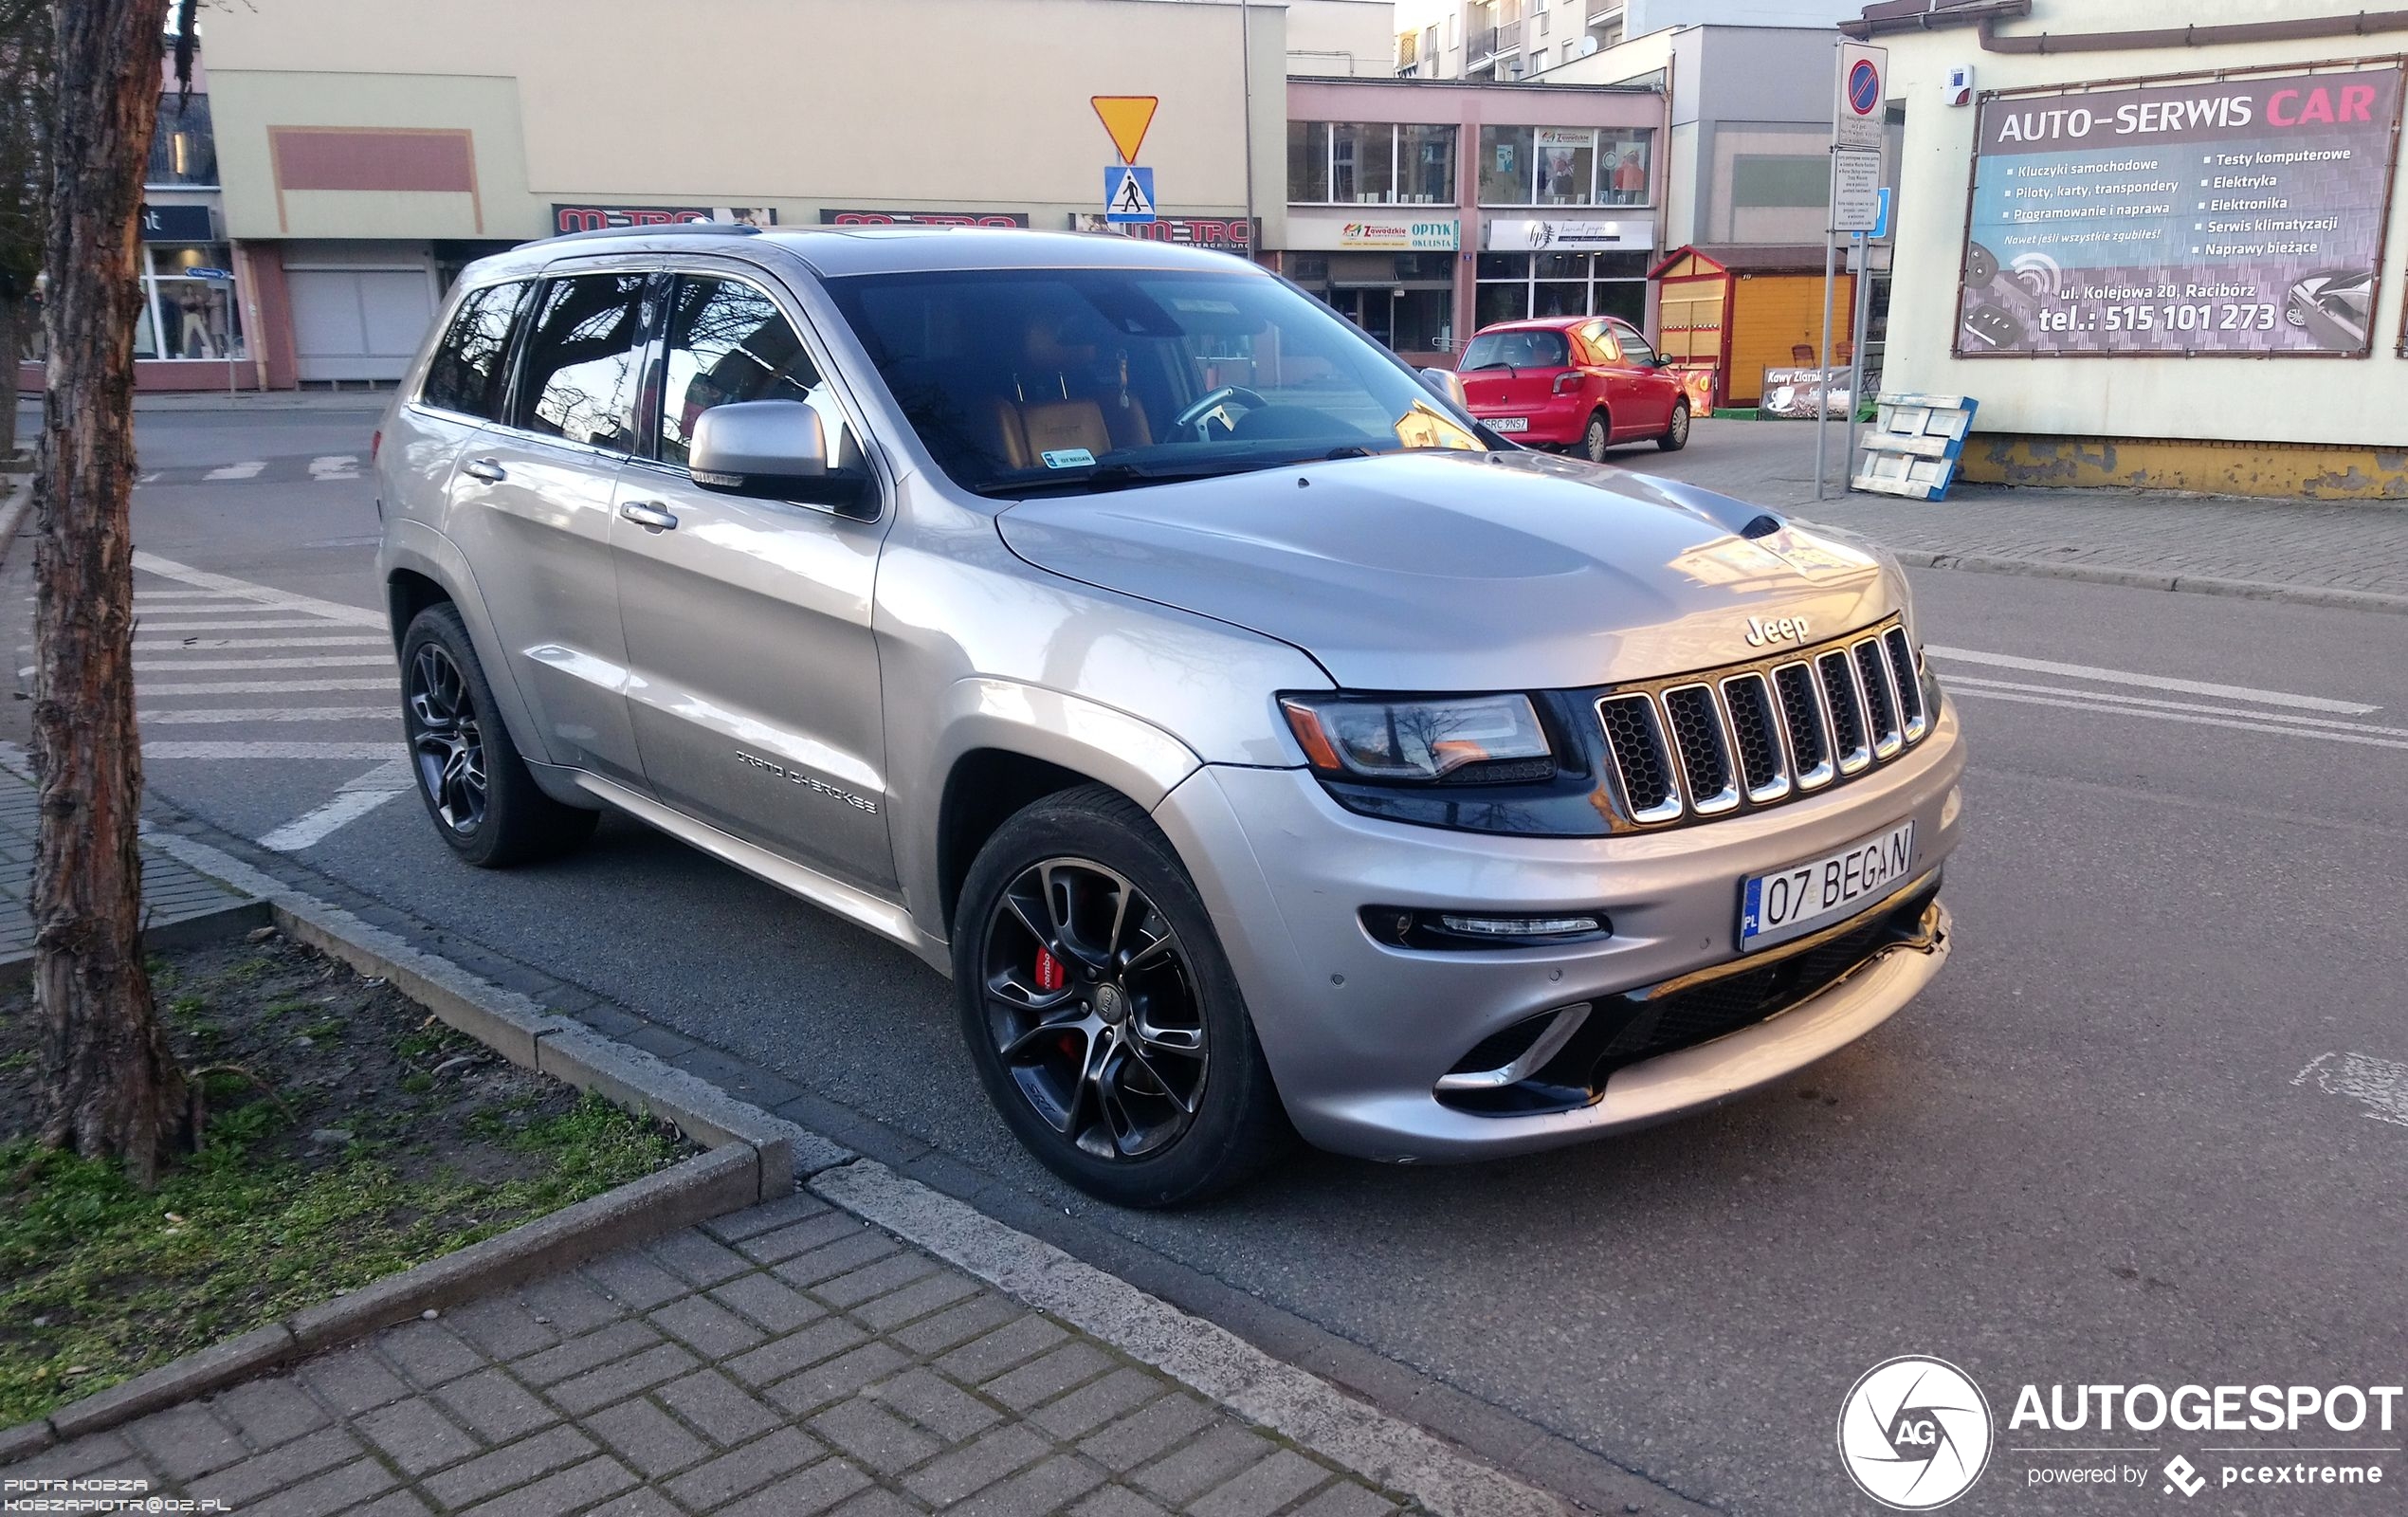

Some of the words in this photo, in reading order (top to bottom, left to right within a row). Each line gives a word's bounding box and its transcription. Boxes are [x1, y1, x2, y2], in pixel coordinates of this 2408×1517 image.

[1998, 96, 2253, 143] AUTO-SERWIS
[2265, 85, 2377, 127] CAR
[2216, 154, 2253, 168] Testy
[2255, 149, 2351, 165] komputerowe
[2017, 163, 2069, 178] Kluczyki
[2071, 158, 2159, 175] samochodowe
[2016, 186, 2054, 200] Piloty,
[2056, 185, 2091, 198] karty,
[2094, 179, 2180, 195] transpondery
[2213, 174, 2277, 190] Elektryka
[2014, 204, 2107, 221] Programowanie
[2109, 204, 2114, 215] i
[2116, 203, 2170, 218] naprawa
[2210, 197, 2288, 211] Elektronika
[1412, 224, 1450, 235] OPTYK
[2208, 220, 2252, 233] Serwis
[2254, 216, 2338, 232] klimatyzacji
[2004, 235, 2036, 246] Nawet
[2038, 232, 2059, 247] jeśli
[2061, 231, 2110, 246] wszystkie
[2112, 228, 2162, 244] zgubiłeś!
[2205, 243, 2264, 257] Naprawy
[2267, 241, 2318, 256] bieżące
[2060, 285, 2079, 300] ul.
[2084, 284, 2153, 302] Kolejowa
[2157, 284, 2180, 301] 20,
[2185, 283, 2256, 299] Racibórz
[2039, 305, 2096, 332] tel.:
[2104, 304, 2155, 331] 515
[2162, 303, 2211, 331] 101
[2219, 303, 2276, 330] 273
[1768, 371, 1792, 385] Kawy
[1486, 419, 1503, 430] SRC
[1745, 616, 1810, 647] Jeep
[1822, 830, 1909, 909] BEGAN
[1744, 915, 1758, 928] PL
